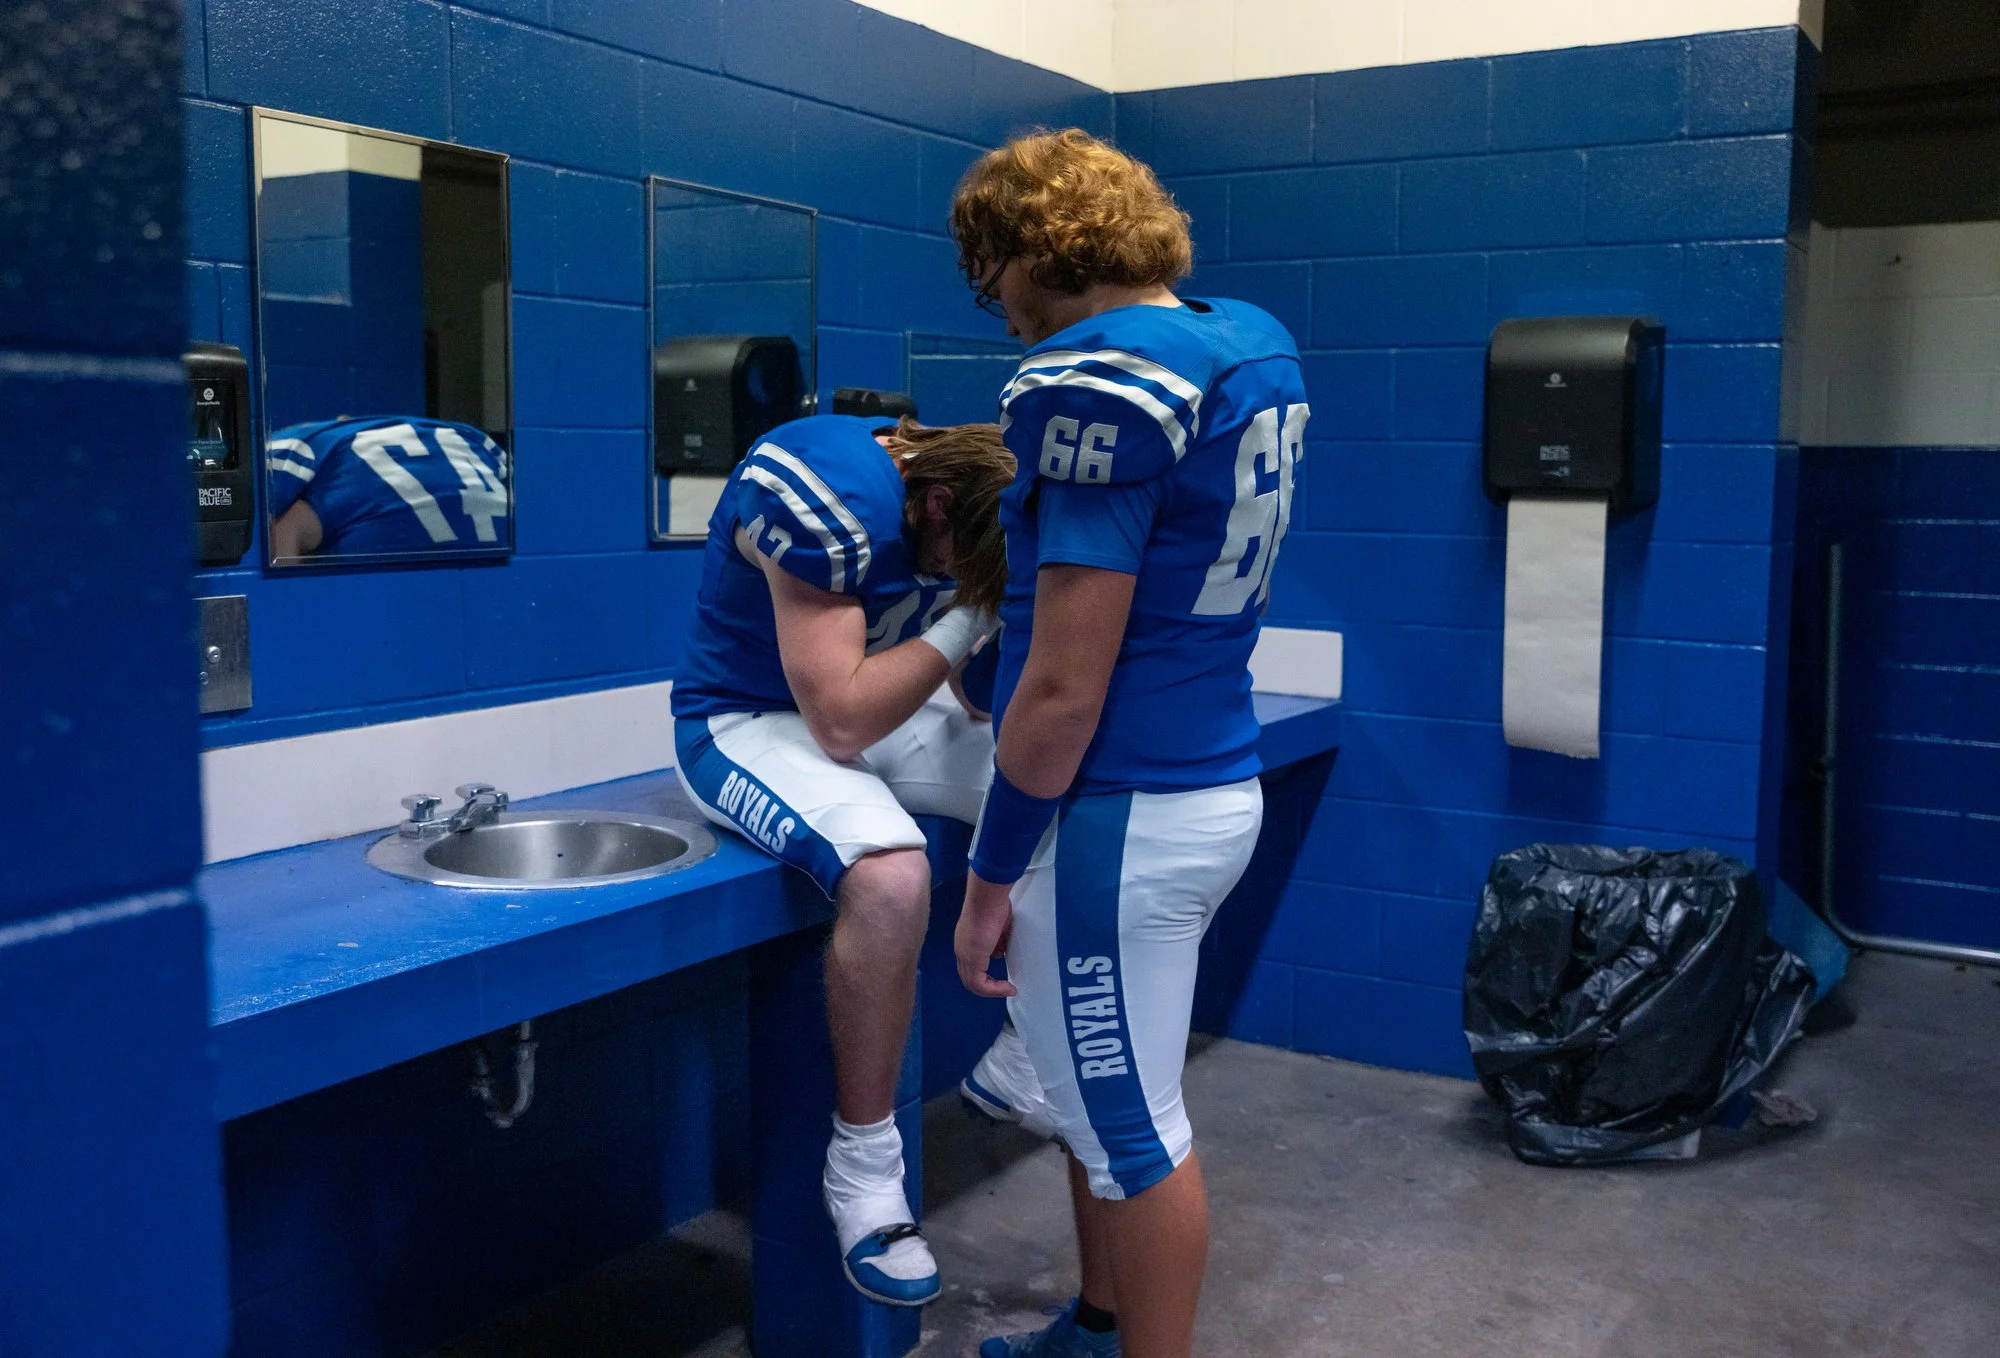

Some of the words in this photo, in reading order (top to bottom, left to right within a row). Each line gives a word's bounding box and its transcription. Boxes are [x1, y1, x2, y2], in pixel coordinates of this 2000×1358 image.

[1038, 415, 1119, 484] 66
[198, 487, 232, 497] PACIFIC
[199, 496, 221, 506] BLUE
[717, 769, 795, 854] ROYALS
[1067, 956, 1129, 1080] ROYALS
